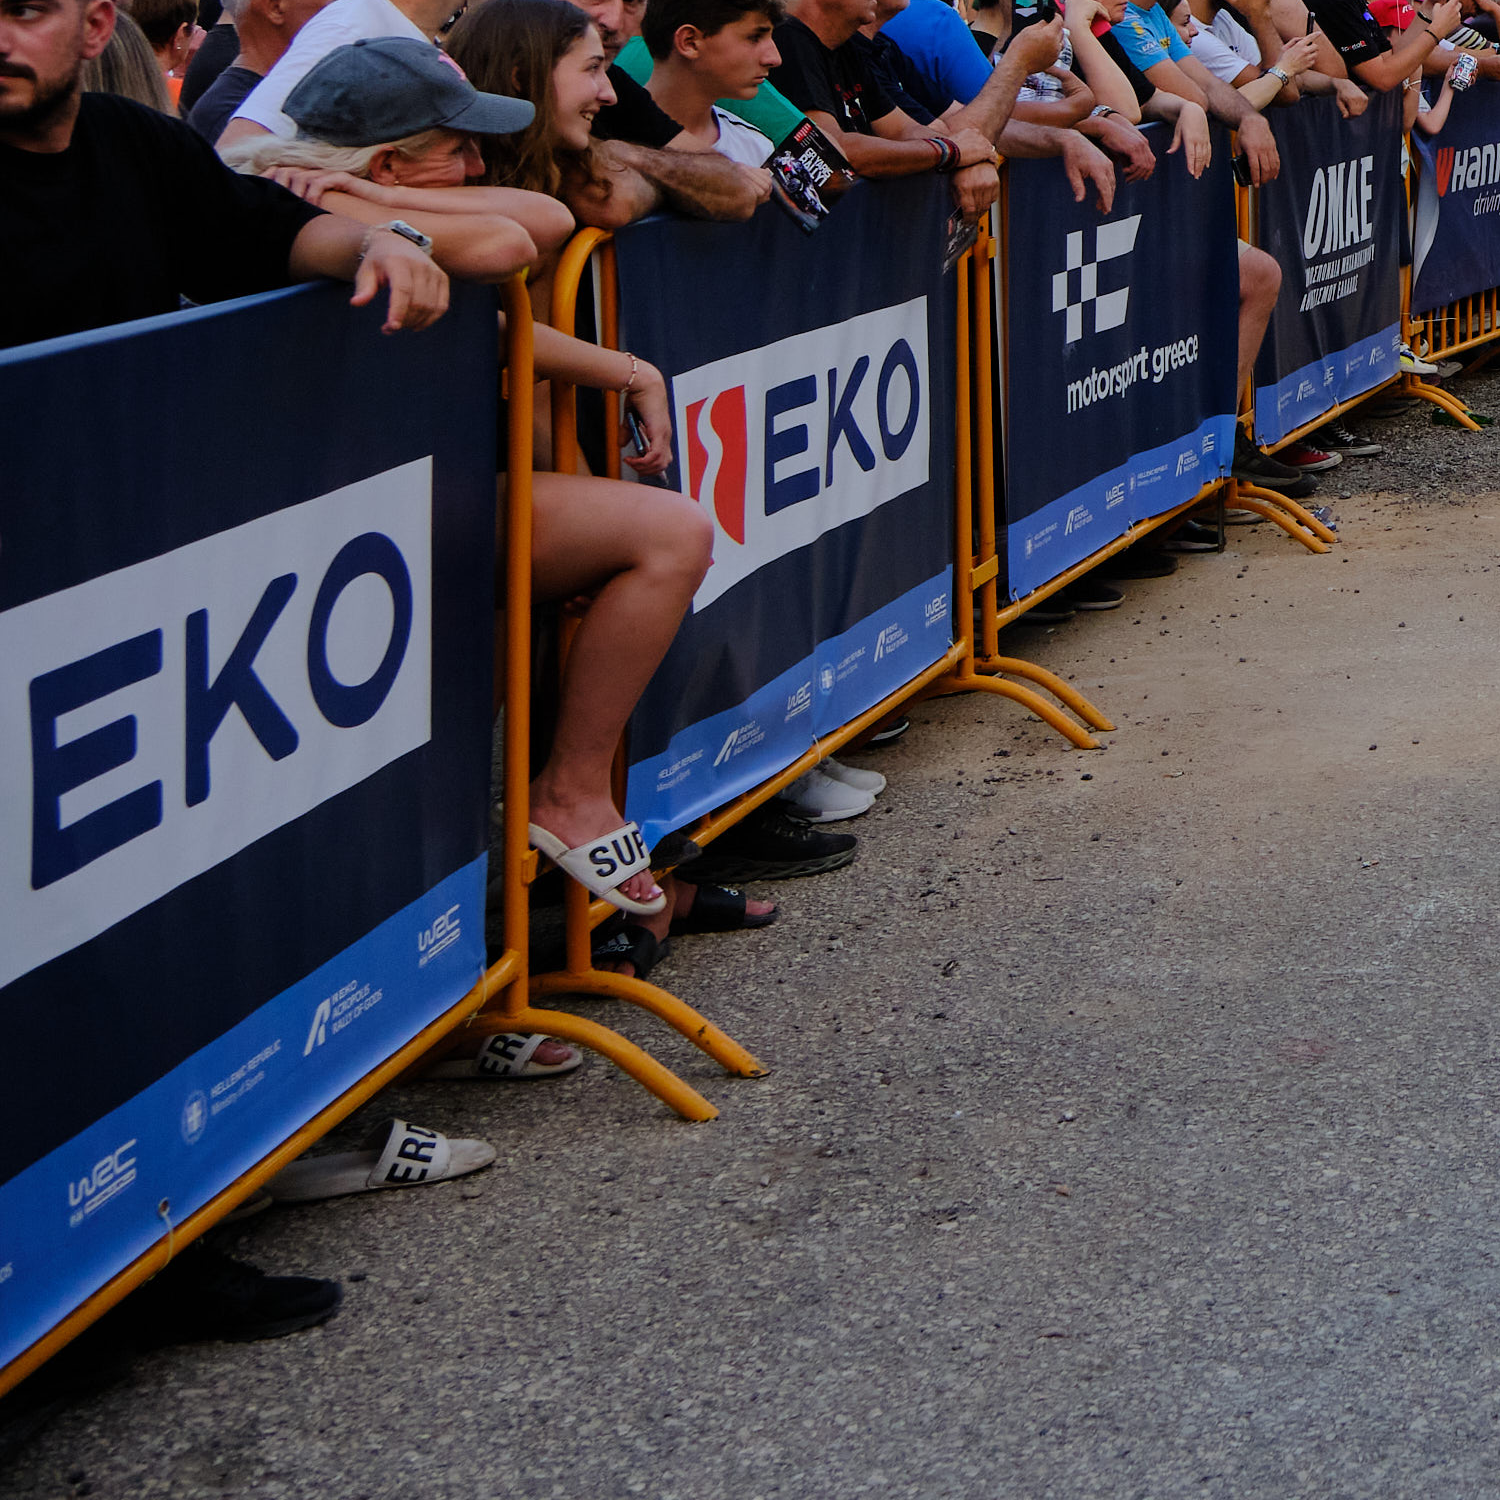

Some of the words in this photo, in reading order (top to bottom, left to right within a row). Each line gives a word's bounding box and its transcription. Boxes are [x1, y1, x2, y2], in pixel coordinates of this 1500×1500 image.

[1067, 346, 1149, 414] motorsport
[1152, 334, 1200, 384] greece
[765, 338, 920, 517] EKO
[29, 531, 414, 891] EKO
[419, 903, 461, 952] WRC
[68, 1138, 137, 1206] WRC
